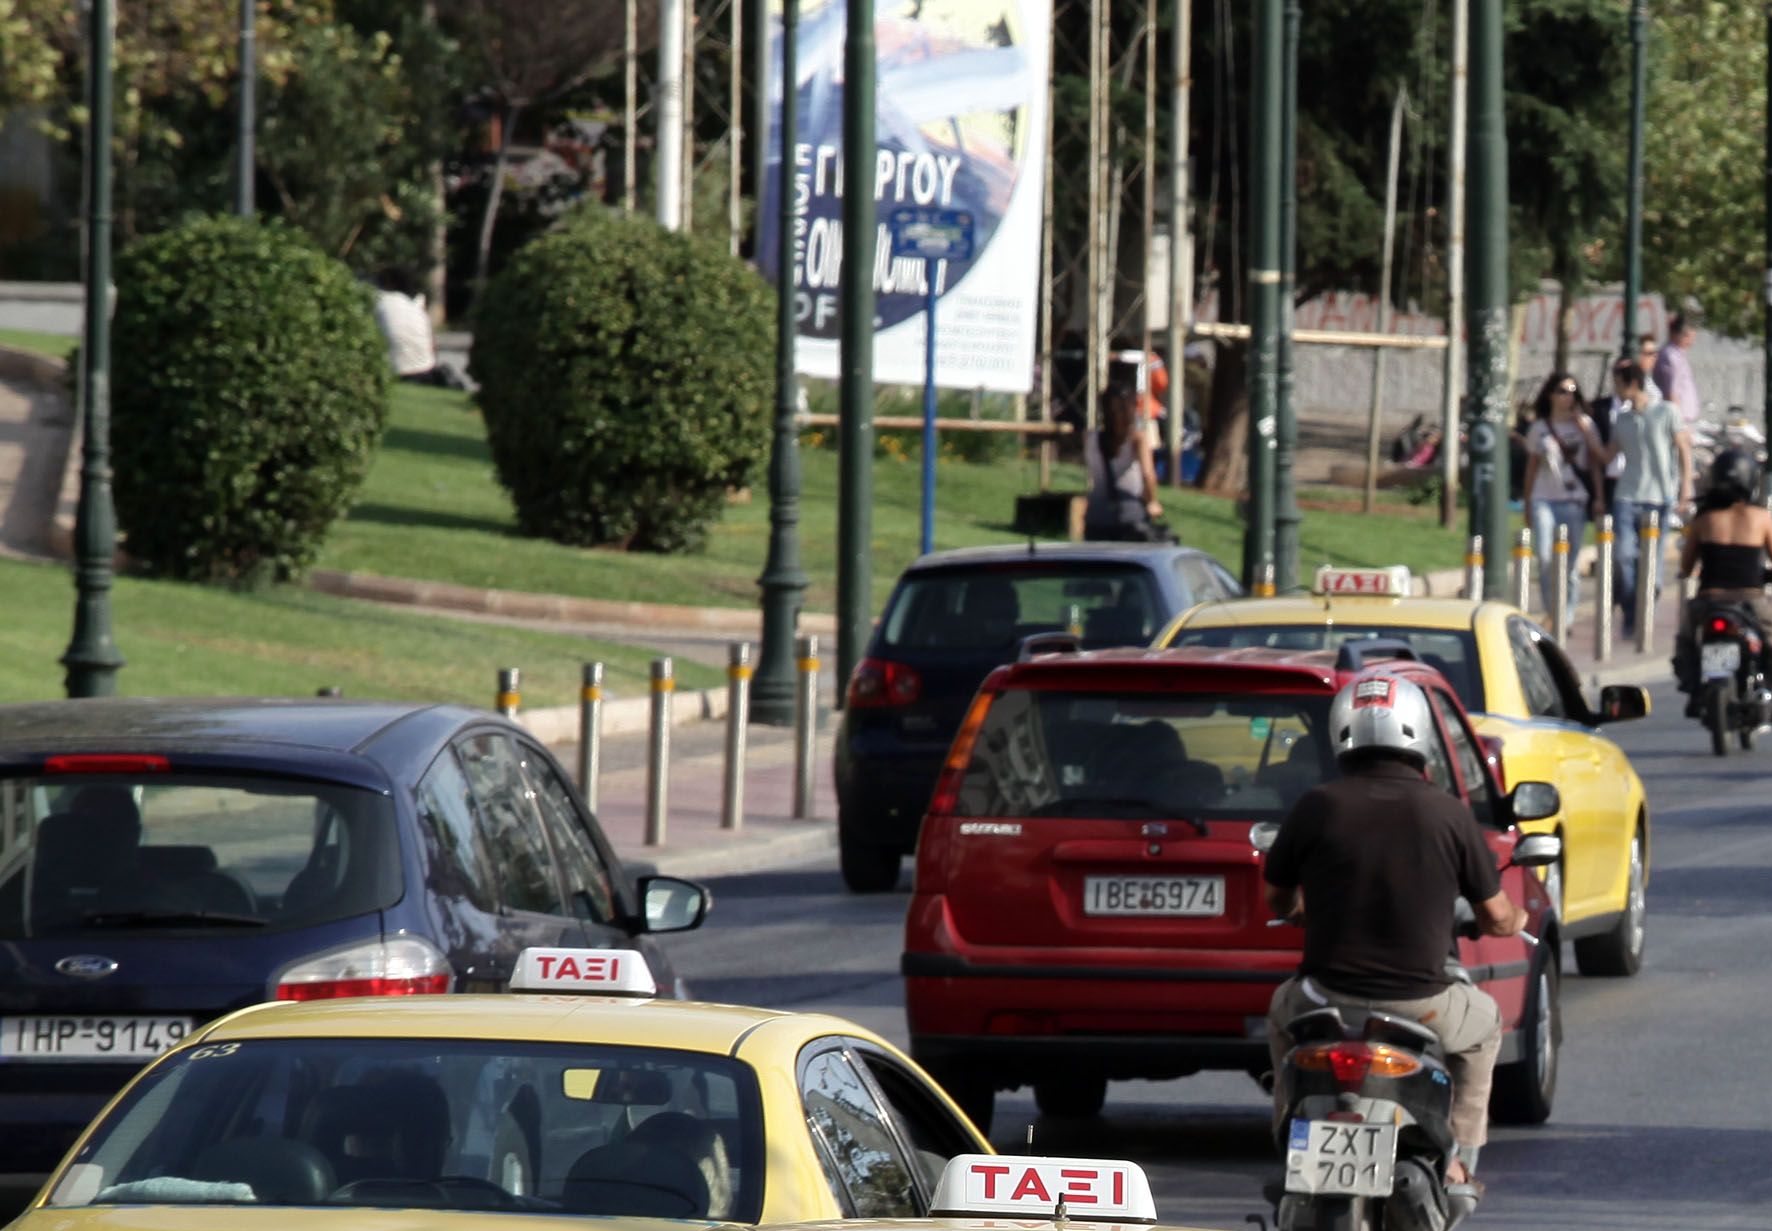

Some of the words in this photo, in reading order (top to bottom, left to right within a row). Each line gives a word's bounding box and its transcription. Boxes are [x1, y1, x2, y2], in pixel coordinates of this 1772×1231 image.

[536, 956, 620, 981] ΤΑΞΙ
[1320, 1127, 1381, 1156] ZXT
[971, 1165, 1124, 1205] ΤΑΞΙ
